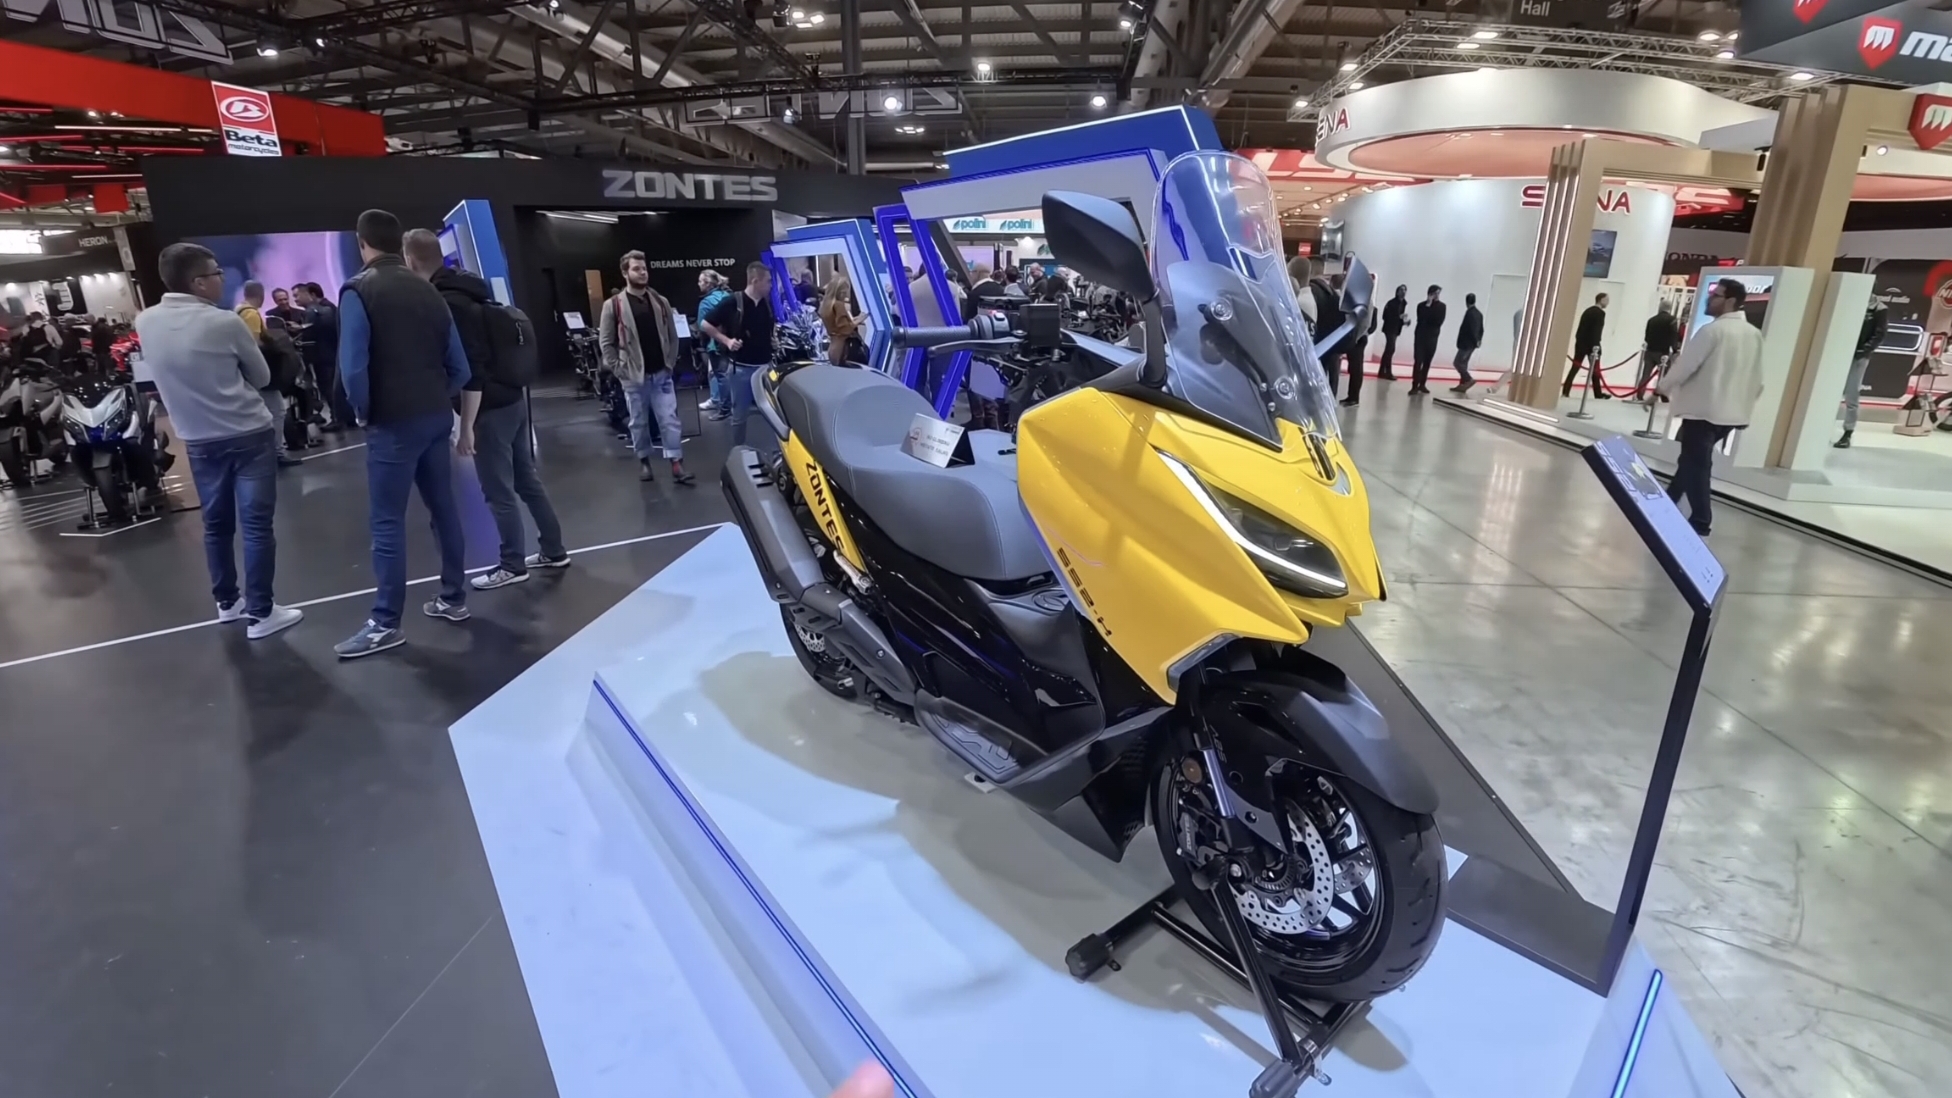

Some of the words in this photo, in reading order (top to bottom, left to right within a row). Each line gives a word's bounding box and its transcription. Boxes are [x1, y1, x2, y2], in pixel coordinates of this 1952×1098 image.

[1520, 0, 1550, 17] Hall
[224, 129, 278, 148] Beta
[228, 143, 280, 156] motorcycles
[602, 169, 779, 202] ZONTES
[1520, 183, 1631, 214] SNA
[961, 218, 987, 230] polini
[1007, 218, 1033, 230] polini
[78, 235, 108, 248] HERON
[650, 259, 685, 269] DREAMS
[686, 259, 713, 268] NEVER
[714, 258, 736, 267] STOP
[805, 462, 845, 550] ZONTES
